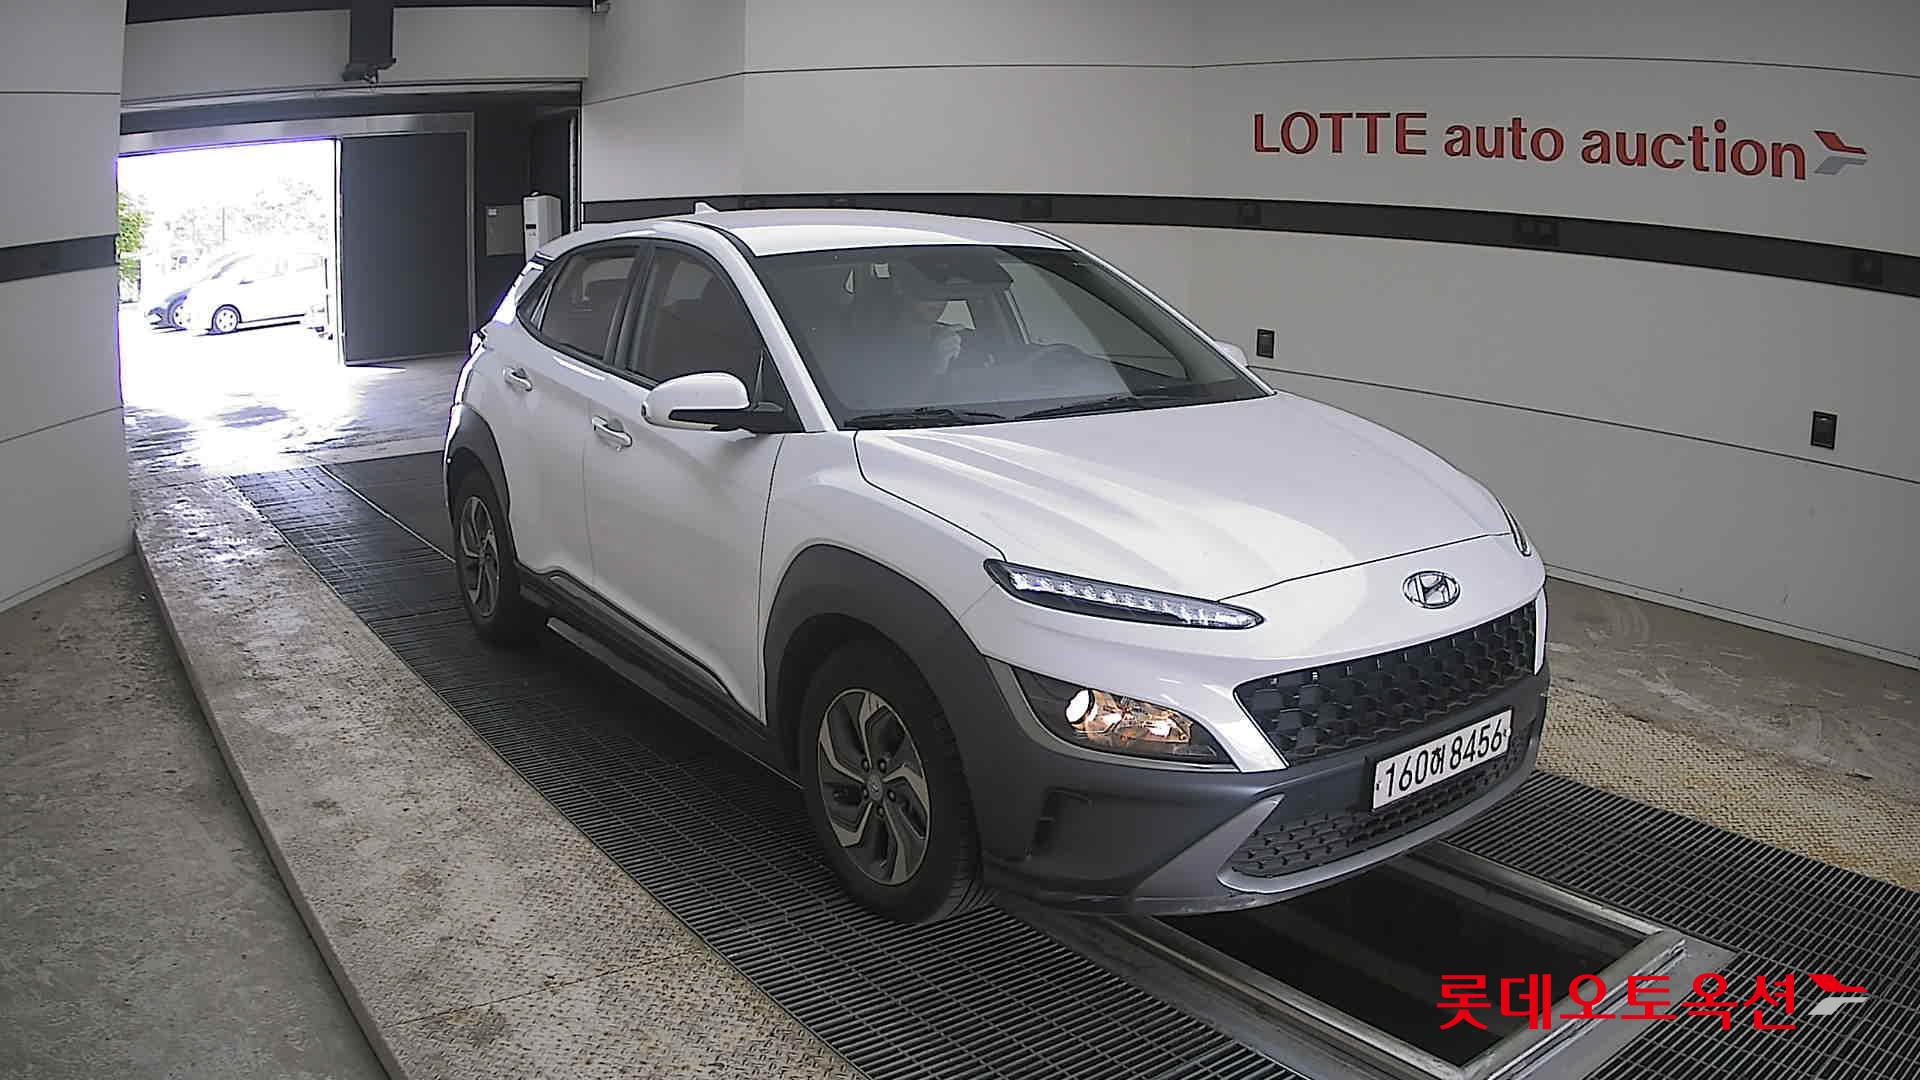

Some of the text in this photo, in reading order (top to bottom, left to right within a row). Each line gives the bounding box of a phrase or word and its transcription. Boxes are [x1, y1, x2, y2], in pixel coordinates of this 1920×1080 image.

[1253, 111, 1806, 181] LOTTE auto auction
